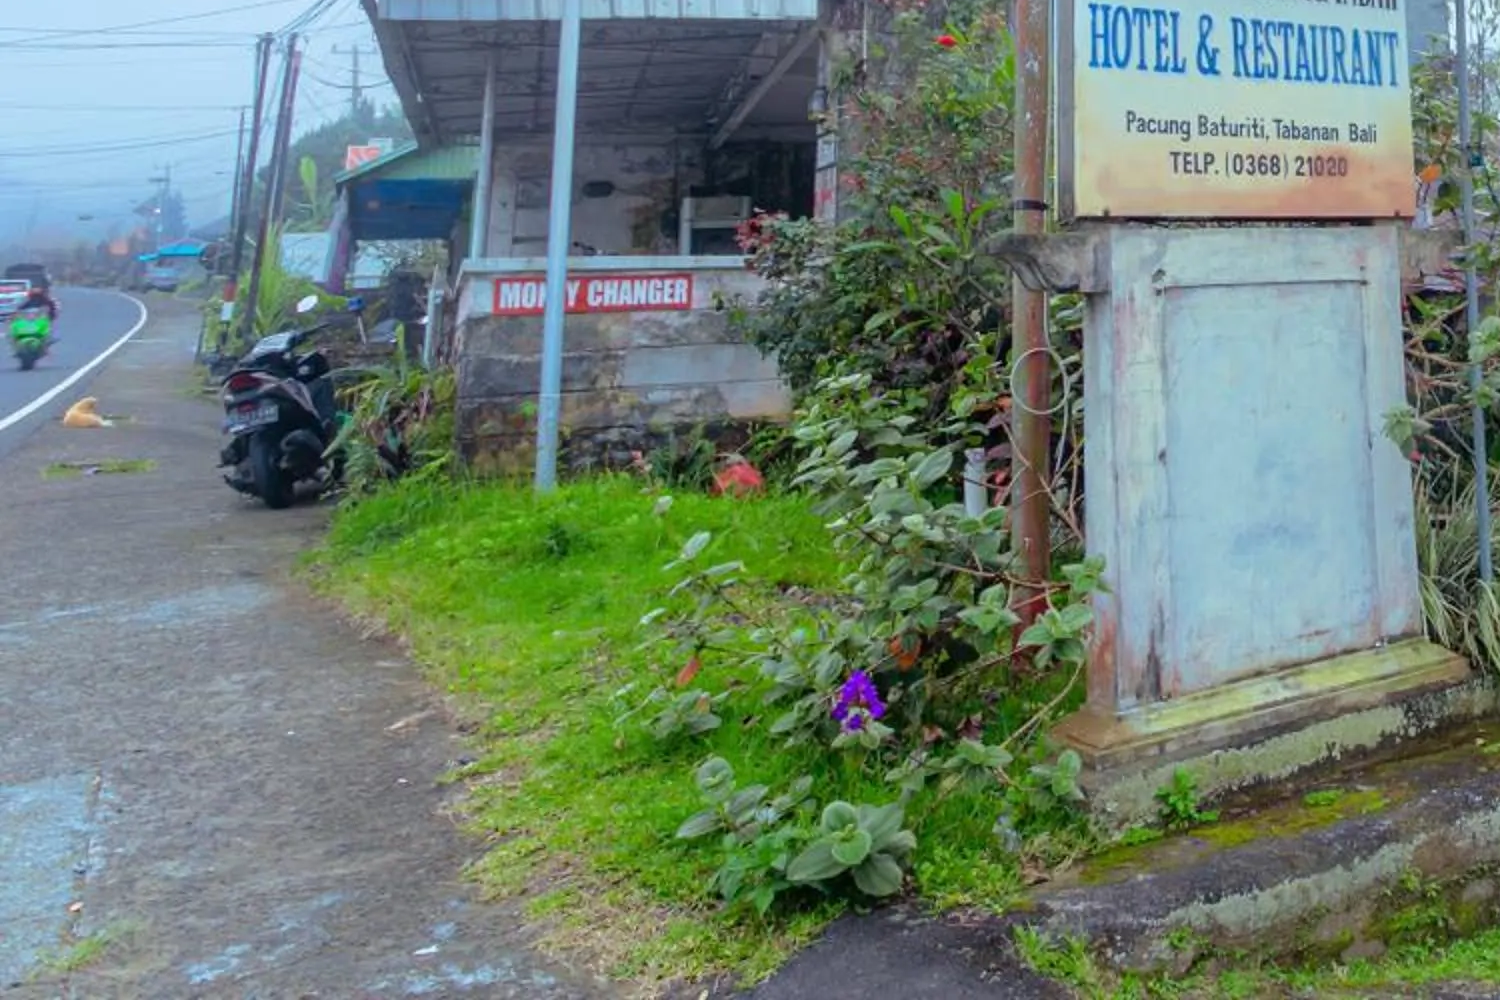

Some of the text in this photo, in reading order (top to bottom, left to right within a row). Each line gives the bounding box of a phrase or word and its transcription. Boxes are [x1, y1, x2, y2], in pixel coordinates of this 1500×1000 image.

[1088, 2, 1399, 87] HOTEL & RESTAURANT
[1126, 110, 1378, 144] Pacung Baturiti, Tabanan Bali
[1169, 151, 1220, 176] TELP.
[1226, 152, 1289, 179] (0368)
[500, 278, 689, 309] MOY CHANGER
